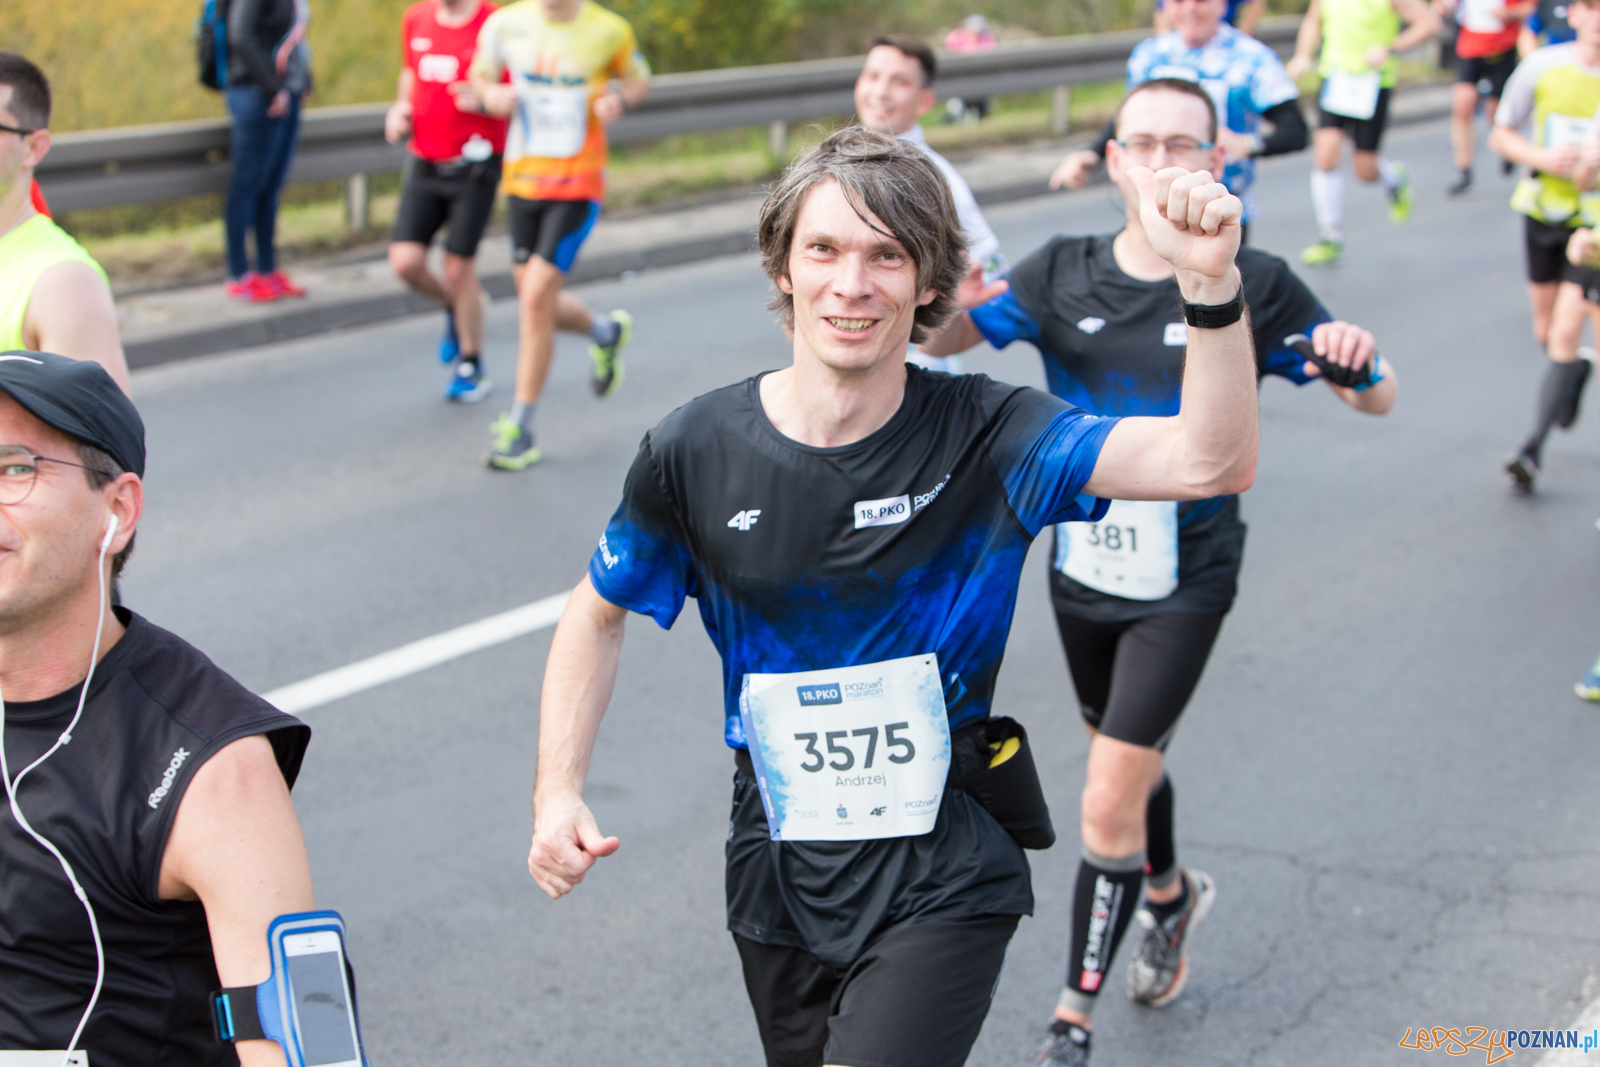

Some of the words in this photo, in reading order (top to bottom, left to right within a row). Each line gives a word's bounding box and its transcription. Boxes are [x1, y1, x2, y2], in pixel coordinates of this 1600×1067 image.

[727, 509, 761, 531] 4F
[860, 508, 877, 520] 18.
[880, 503, 905, 518] PKO
[1087, 523, 1138, 552] 381
[846, 687, 884, 699] maraton
[794, 721, 916, 773] 3575
[147, 747, 191, 809] Reebok
[835, 772, 887, 787] Andrzej
[870, 806, 887, 816] 4F
